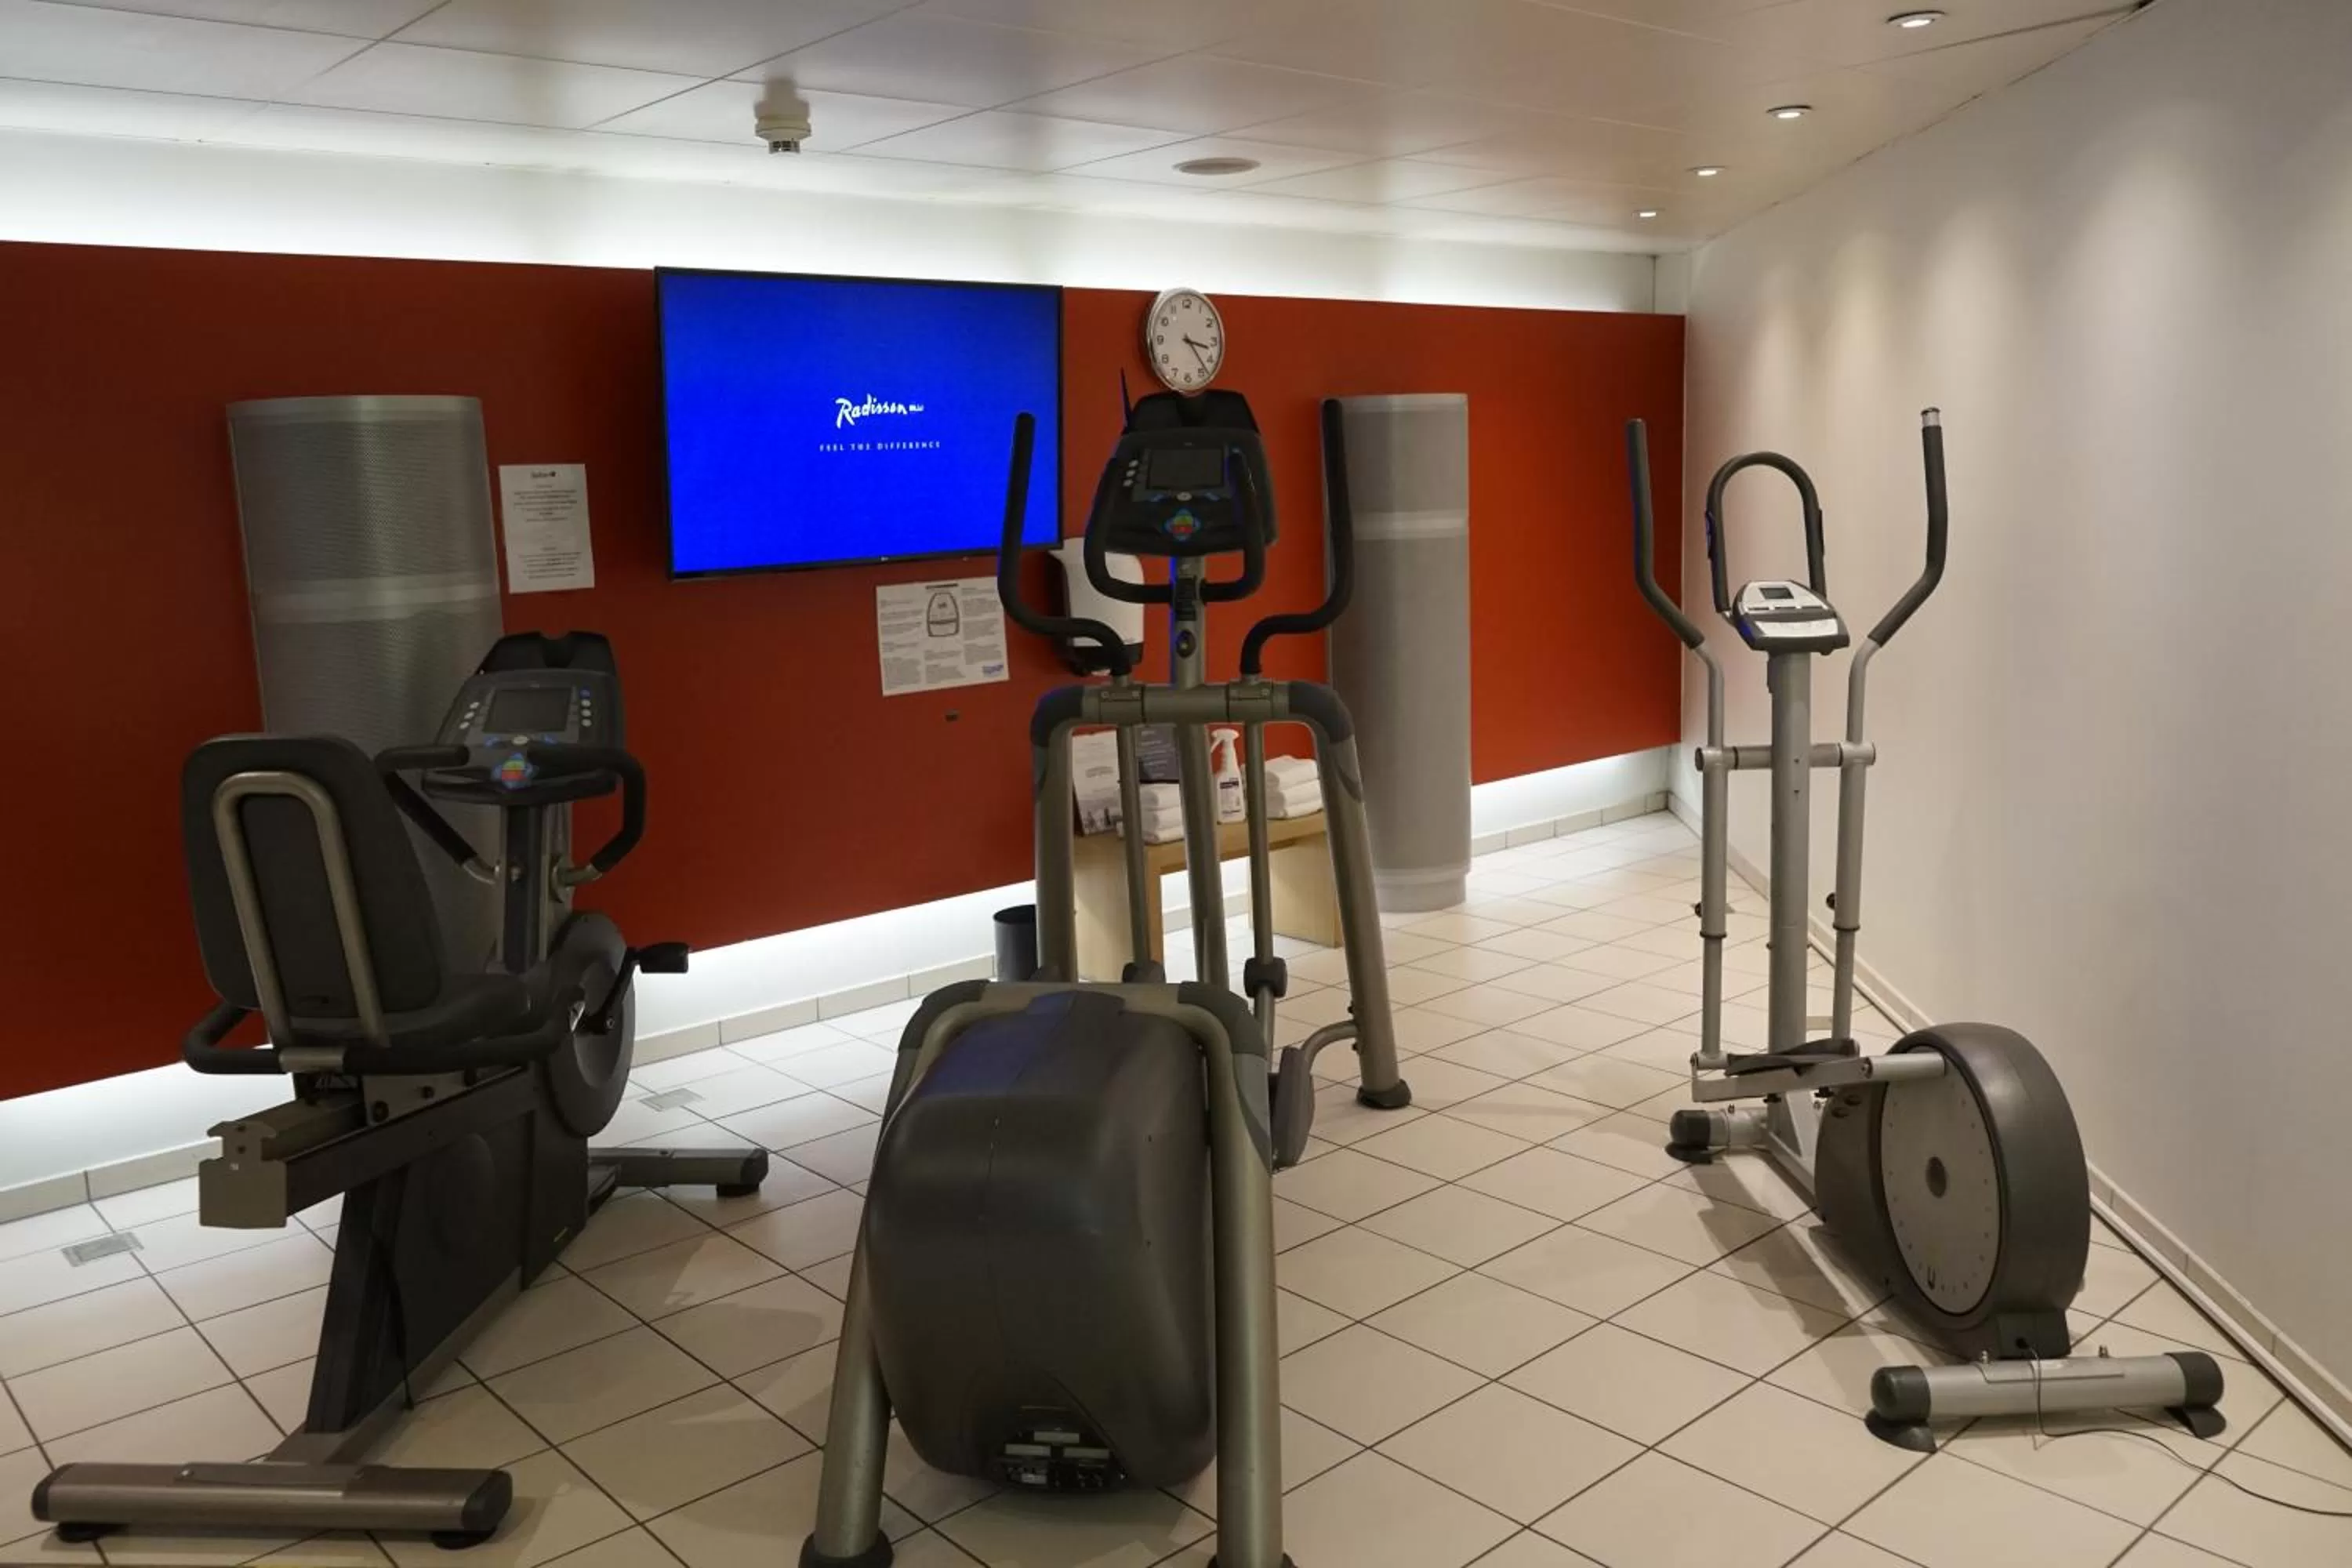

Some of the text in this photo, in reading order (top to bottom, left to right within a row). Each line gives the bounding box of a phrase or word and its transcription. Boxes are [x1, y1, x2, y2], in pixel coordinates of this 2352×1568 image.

[1205, 318, 1214, 328] 2
[1171, 367, 1178, 377] 7
[835, 394, 907, 429] Radisson
[877, 441, 940, 451] DIFFERENCE
